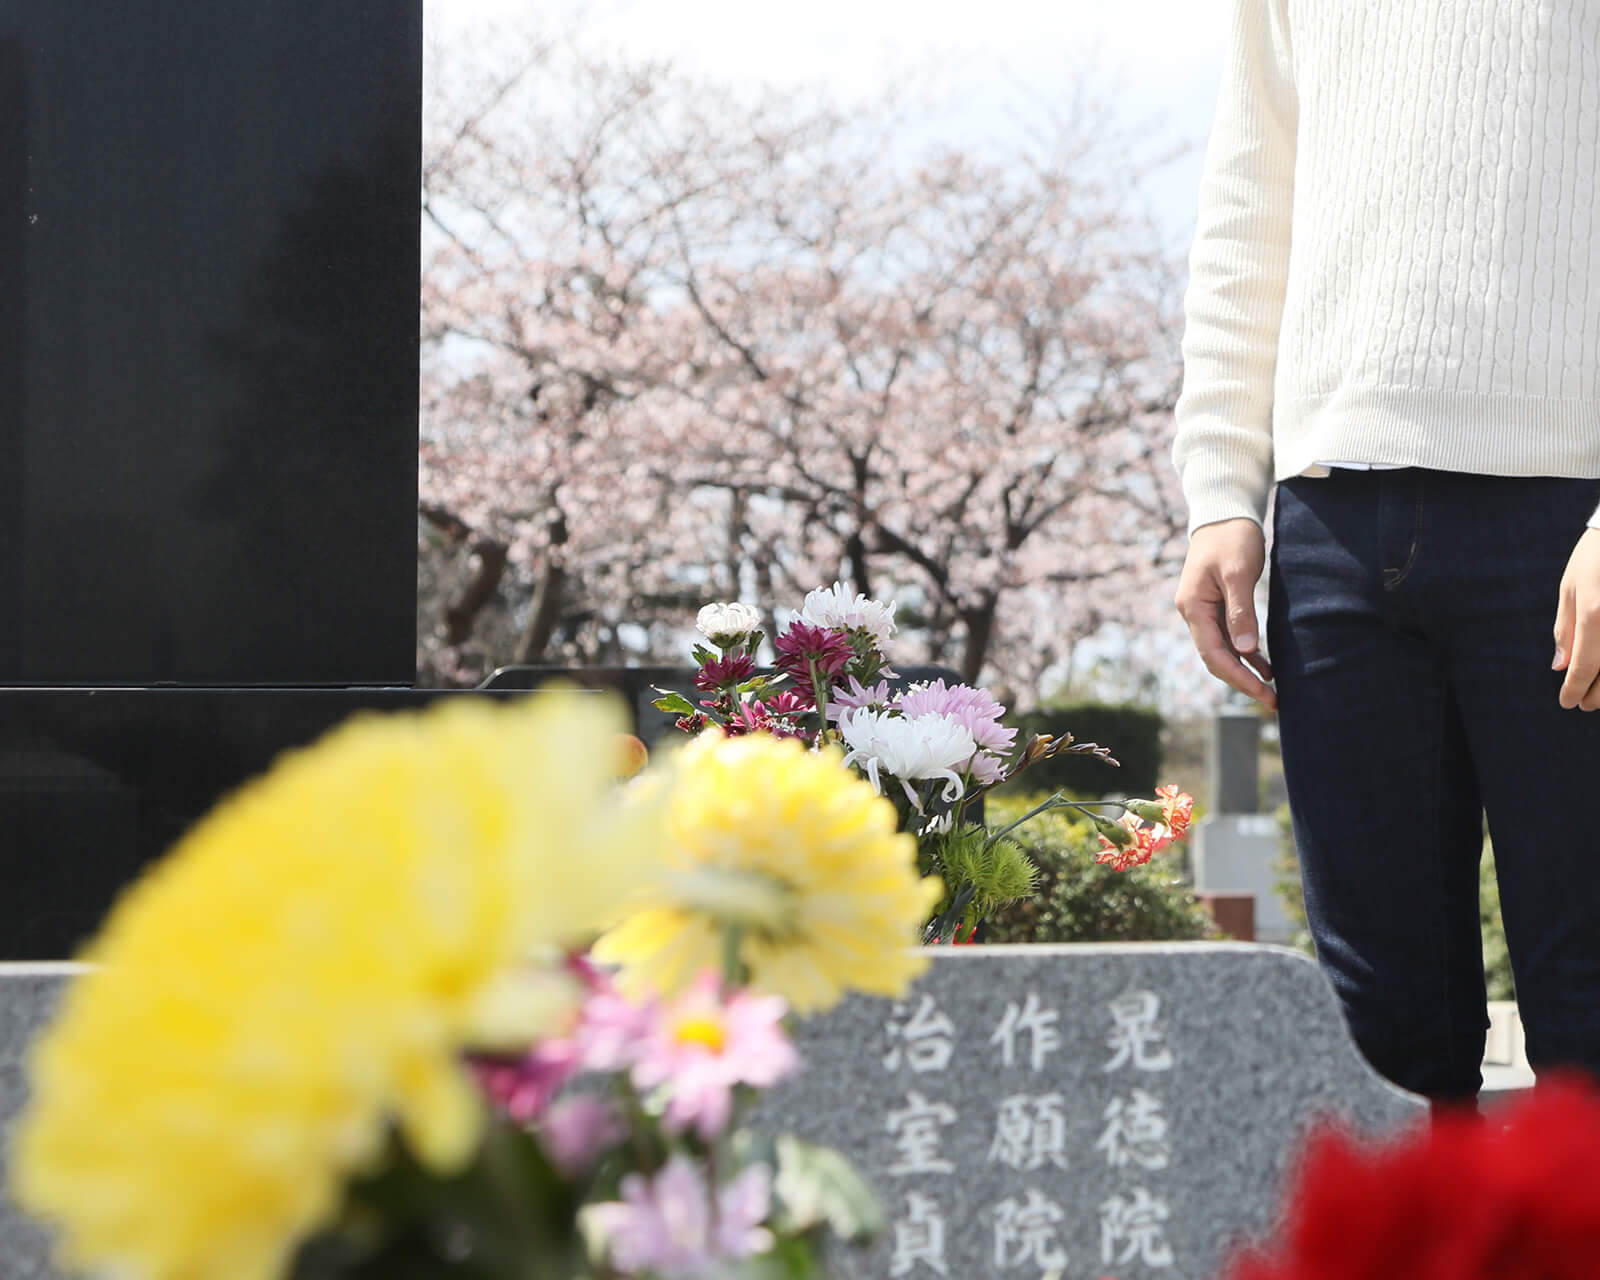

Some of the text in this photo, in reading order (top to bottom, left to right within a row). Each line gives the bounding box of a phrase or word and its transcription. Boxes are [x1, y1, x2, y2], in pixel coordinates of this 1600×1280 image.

[882, 992, 958, 1277] 治室貞
[987, 992, 1069, 1270] 作願院
[1097, 989, 1174, 1267] 晃徳院
